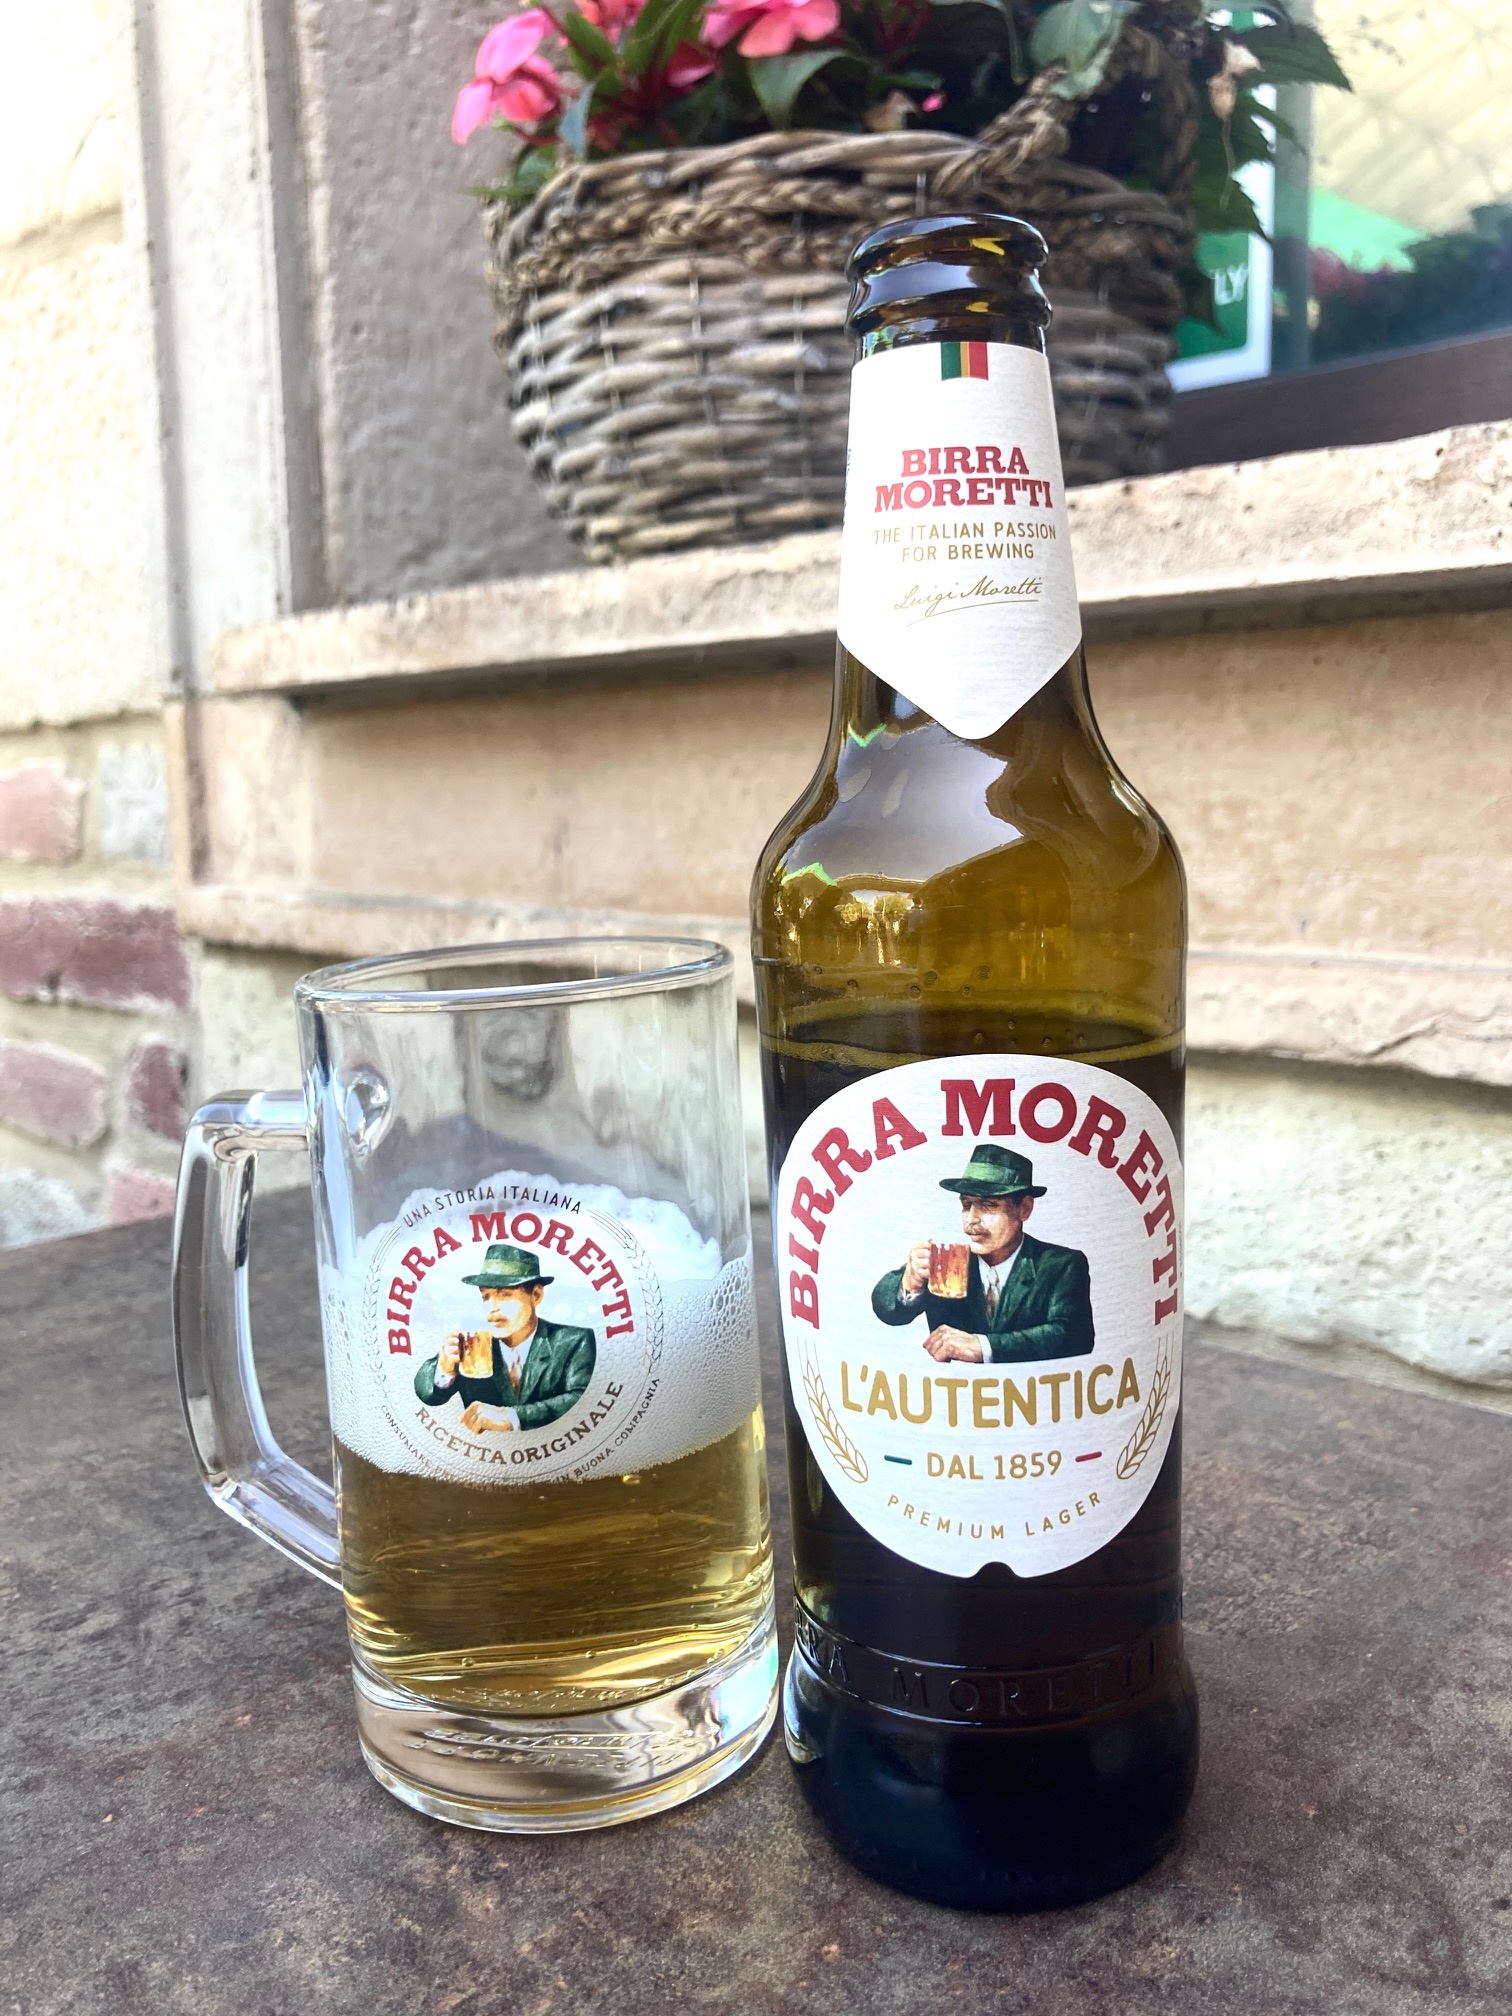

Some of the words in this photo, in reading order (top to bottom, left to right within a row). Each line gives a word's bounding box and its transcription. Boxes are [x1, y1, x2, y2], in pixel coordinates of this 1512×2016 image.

[901, 446, 1030, 478] BIRRA
[874, 477, 1054, 514] MORETTI
[873, 526, 901, 545] THE
[910, 521, 985, 542] ITALIAN
[993, 520, 1057, 541] PASSION
[902, 545, 937, 564] FOR
[947, 542, 1035, 561] BREWING
[893, 582, 958, 618] Luigi
[960, 574, 1043, 598] Moretti
[402, 1204, 433, 1228] UNA
[434, 1185, 495, 1211] STORIA
[503, 1185, 582, 1215] ITALIANA
[790, 1096, 928, 1331] BIRRA
[939, 1077, 1179, 1326] MORETTI
[386, 1226, 463, 1356] BIRRA
[468, 1210, 635, 1339] MORETTI
[840, 1357, 1142, 1429] L'AUTENTICA
[415, 1406, 507, 1465] RICETTA
[510, 1381, 624, 1465] ORIGINALE
[573, 1447, 614, 1479] BUONA
[614, 1378, 660, 1447] COMPAGNIA
[927, 1451, 984, 1480] DAL
[994, 1449, 1063, 1480] 1859
[887, 1494, 1006, 1540] PREMIUM
[1025, 1491, 1101, 1537] LAGER
[890, 1641, 1157, 1716] MORETTI
